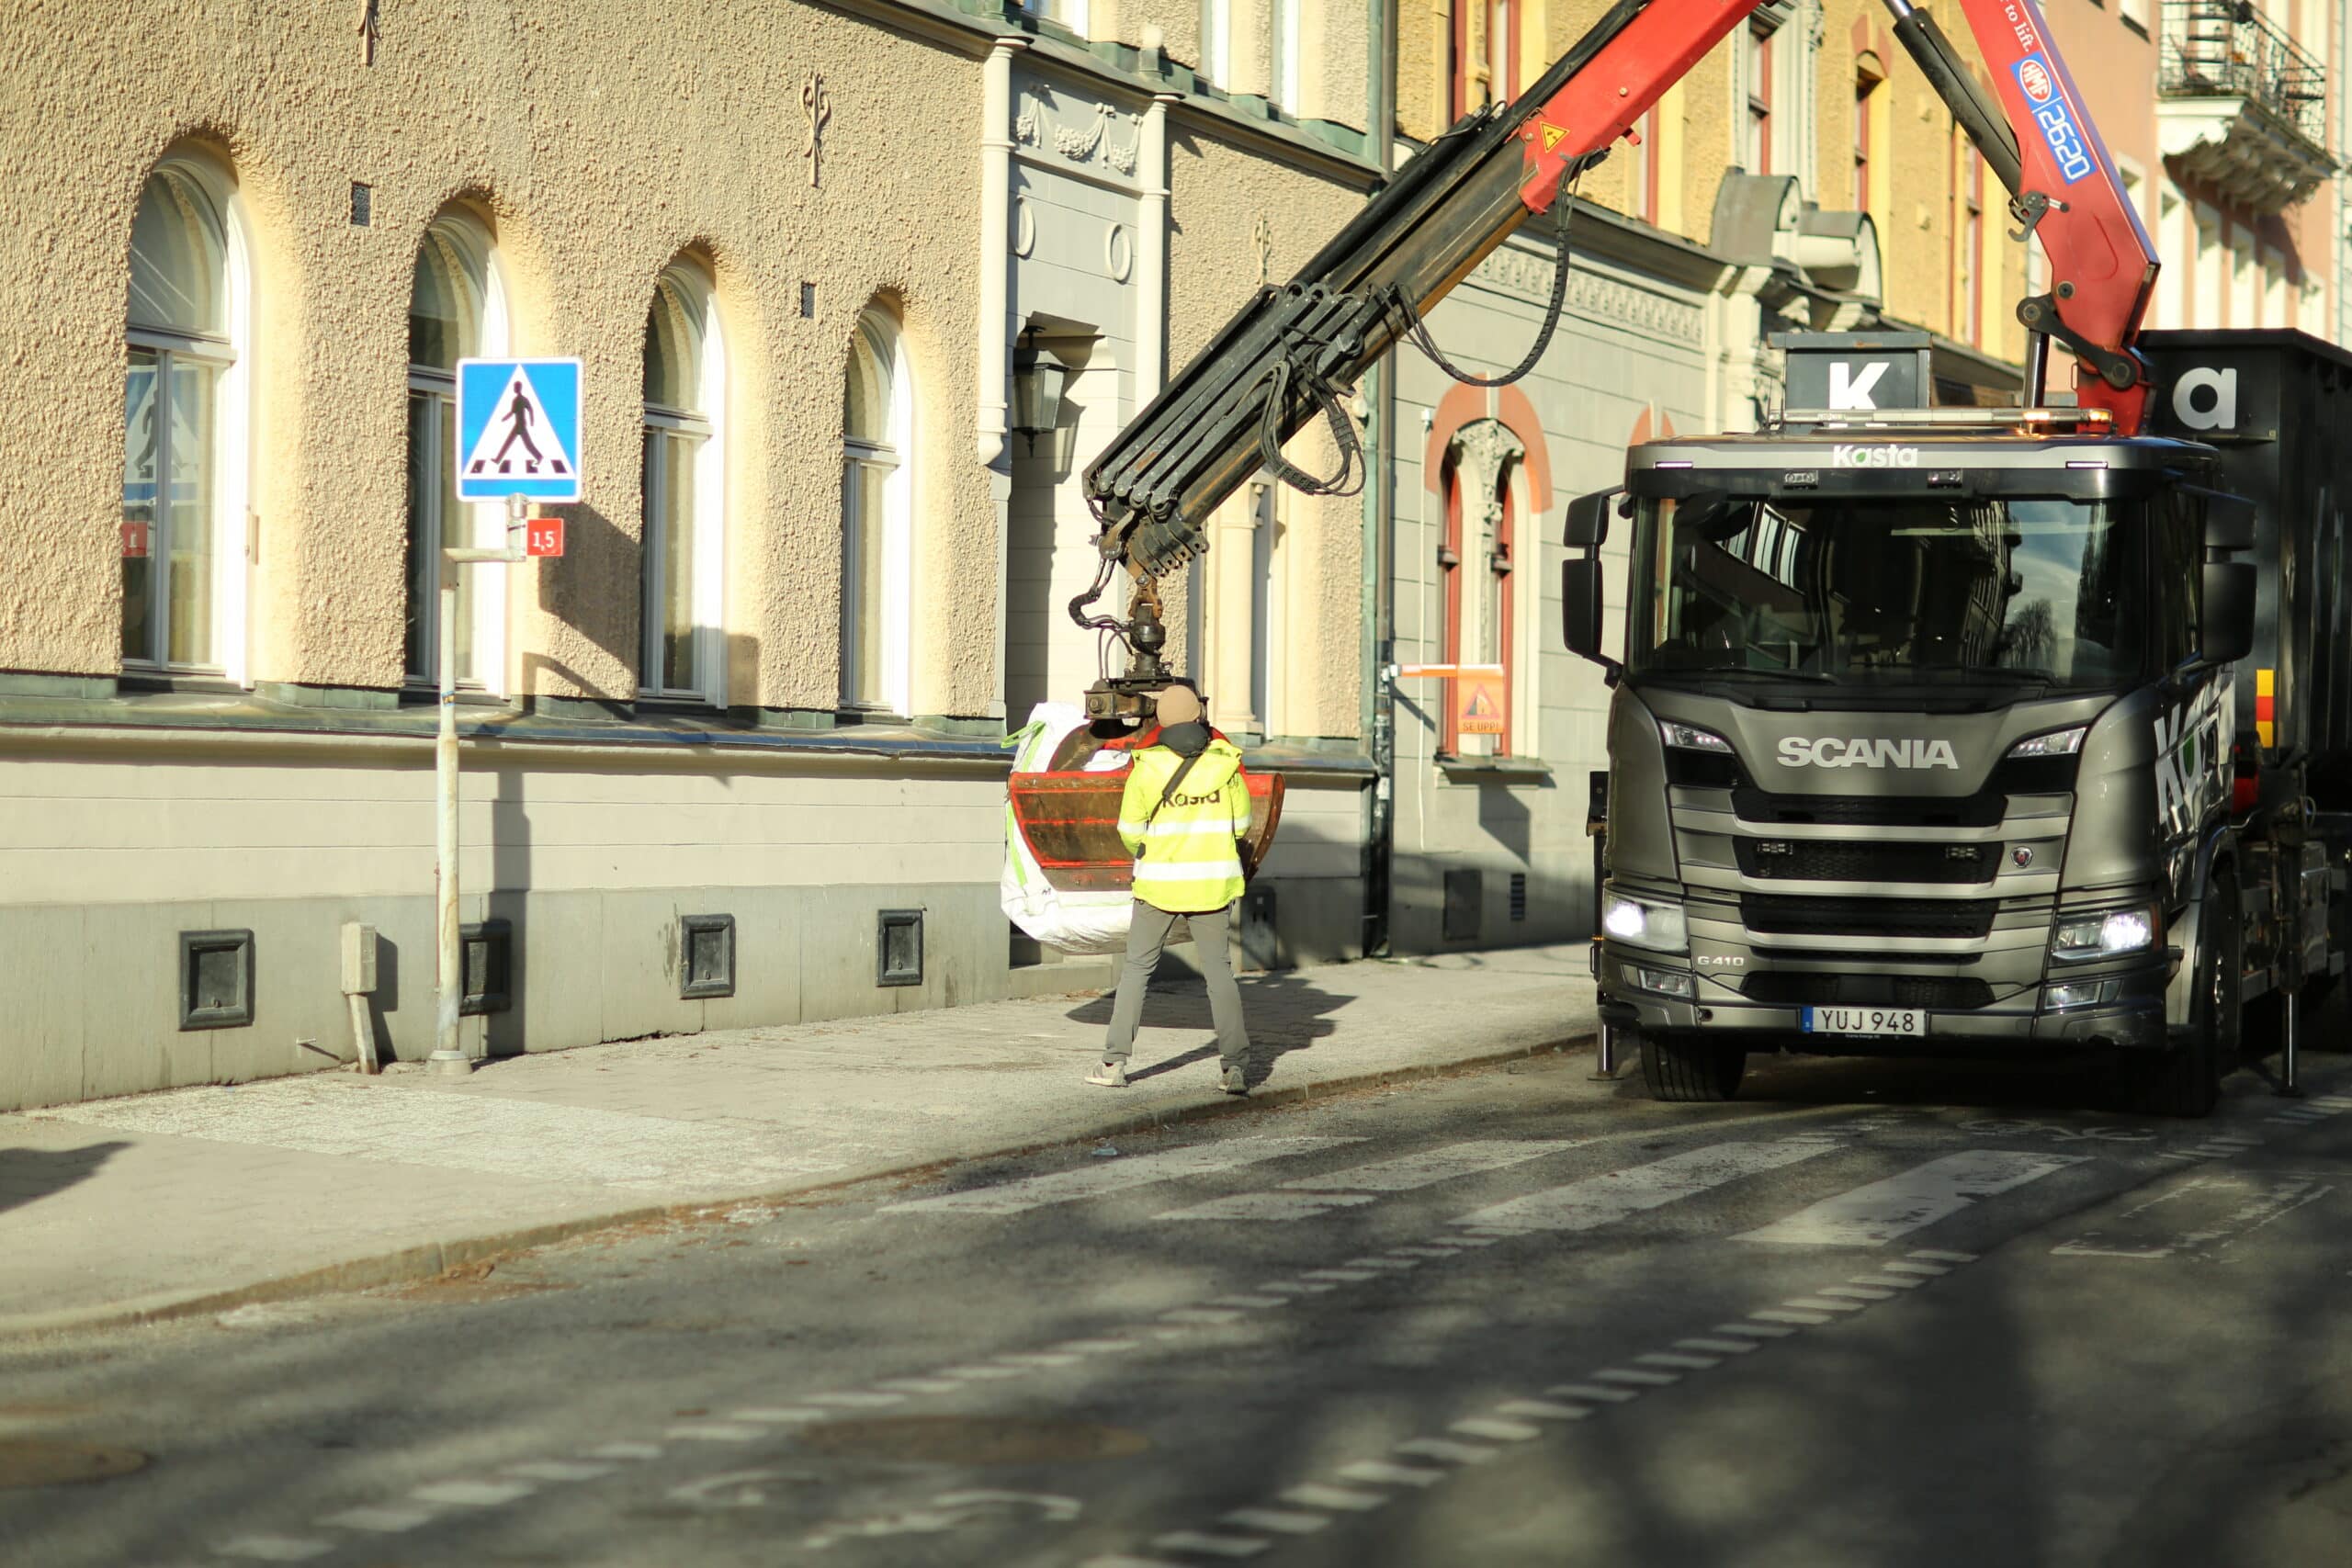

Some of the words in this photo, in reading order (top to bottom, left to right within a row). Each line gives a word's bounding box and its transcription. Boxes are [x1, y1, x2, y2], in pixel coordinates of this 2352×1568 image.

[2005, 4, 2018, 22] to
[2014, 21, 2034, 52] lift.
[2023, 63, 2048, 96] HMF
[2038, 105, 2091, 180] 2620
[1828, 362, 1890, 427] K
[2173, 367, 2237, 430] a
[1833, 444, 1918, 468] Kasta
[533, 530, 555, 552] 1,5
[1463, 721, 1475, 732] SE
[1477, 721, 1499, 732] UPP!
[1777, 737, 1960, 770] SCANIA
[1821, 1010, 1863, 1030] YUJ
[1871, 1011, 1915, 1032] 948
